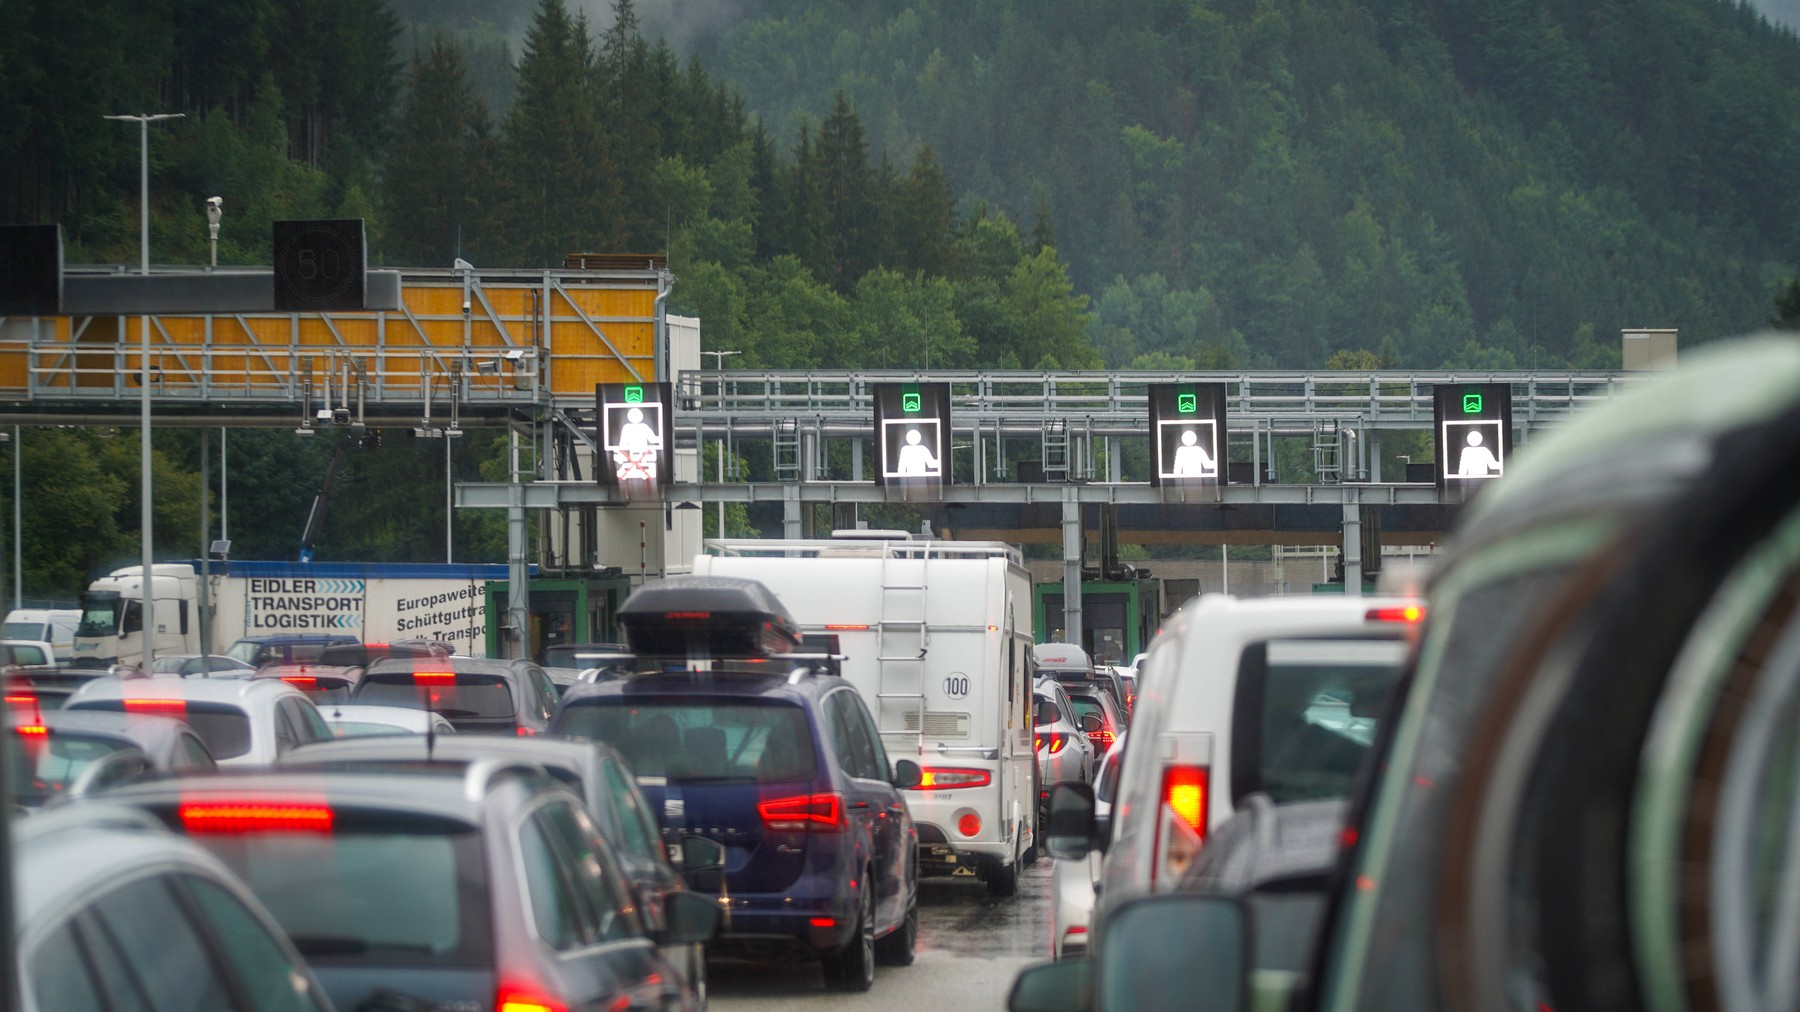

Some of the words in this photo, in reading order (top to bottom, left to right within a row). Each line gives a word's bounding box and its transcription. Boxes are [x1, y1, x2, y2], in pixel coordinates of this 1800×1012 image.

[297, 248, 340, 280] 50
[251, 579, 316, 593] EIDLER
[251, 597, 363, 611] TRANSPORT
[397, 585, 486, 612] Europaweite
[254, 613, 339, 628] LOGISTIK
[945, 677, 969, 696] 100
